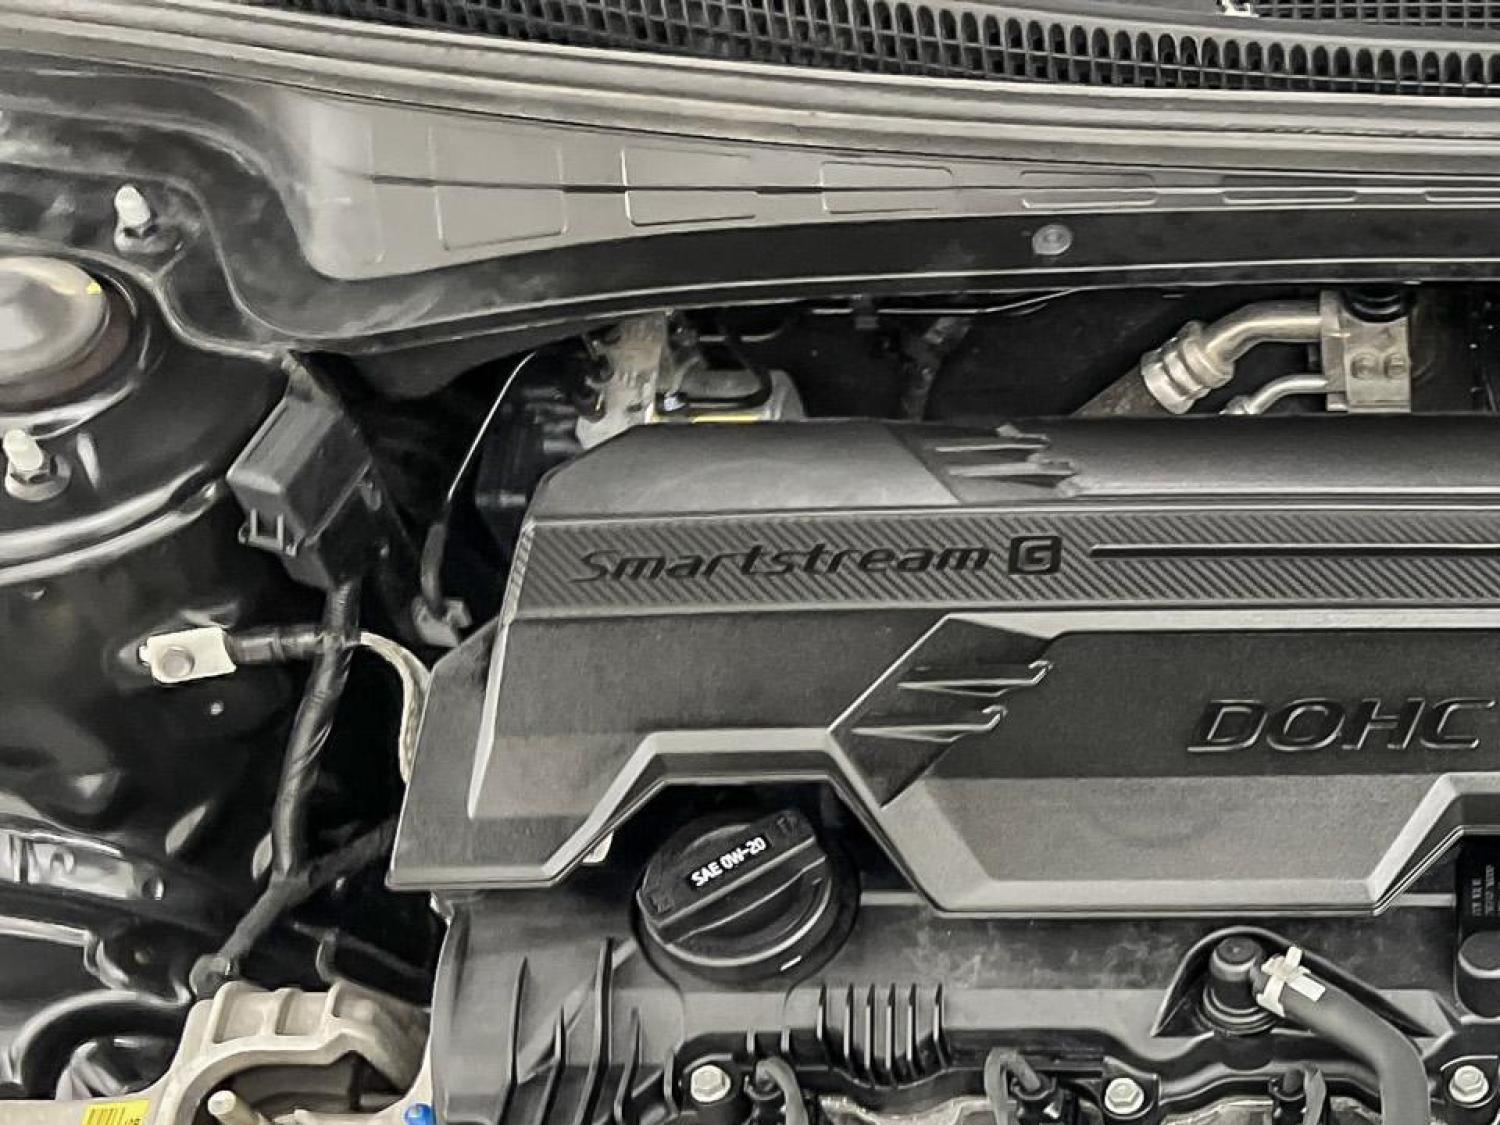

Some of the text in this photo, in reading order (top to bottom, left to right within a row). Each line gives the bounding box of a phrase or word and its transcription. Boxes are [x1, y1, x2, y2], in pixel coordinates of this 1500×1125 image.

[569, 542, 991, 584] Smartstream
[1187, 696, 1497, 753] DOHC
[691, 836, 767, 887] SAE 0W-20
